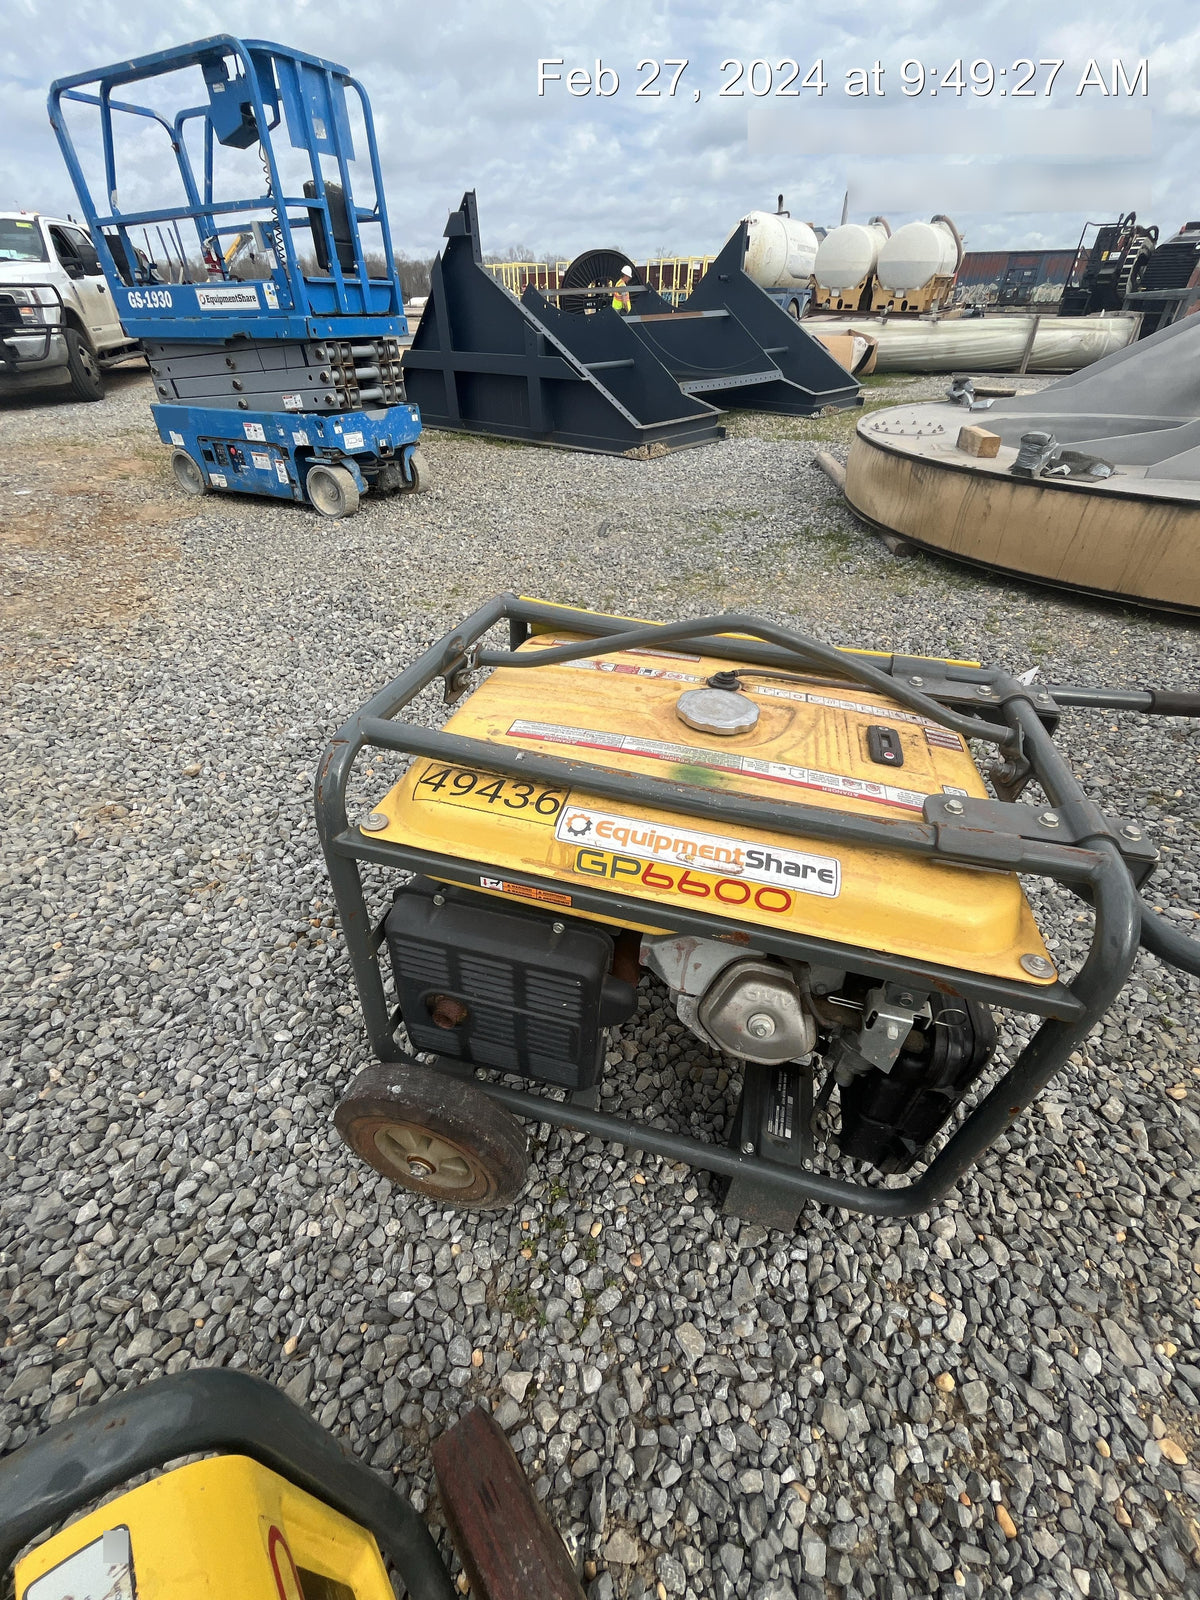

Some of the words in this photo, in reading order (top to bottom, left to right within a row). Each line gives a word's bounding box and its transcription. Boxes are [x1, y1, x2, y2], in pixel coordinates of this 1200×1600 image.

[127, 290, 173, 309] GS-1930
[206, 294, 257, 305] EquipmentShare
[420, 768, 561, 816] 49436
[594, 820, 837, 885] EquipmentShare
[575, 848, 793, 914] GP6600
